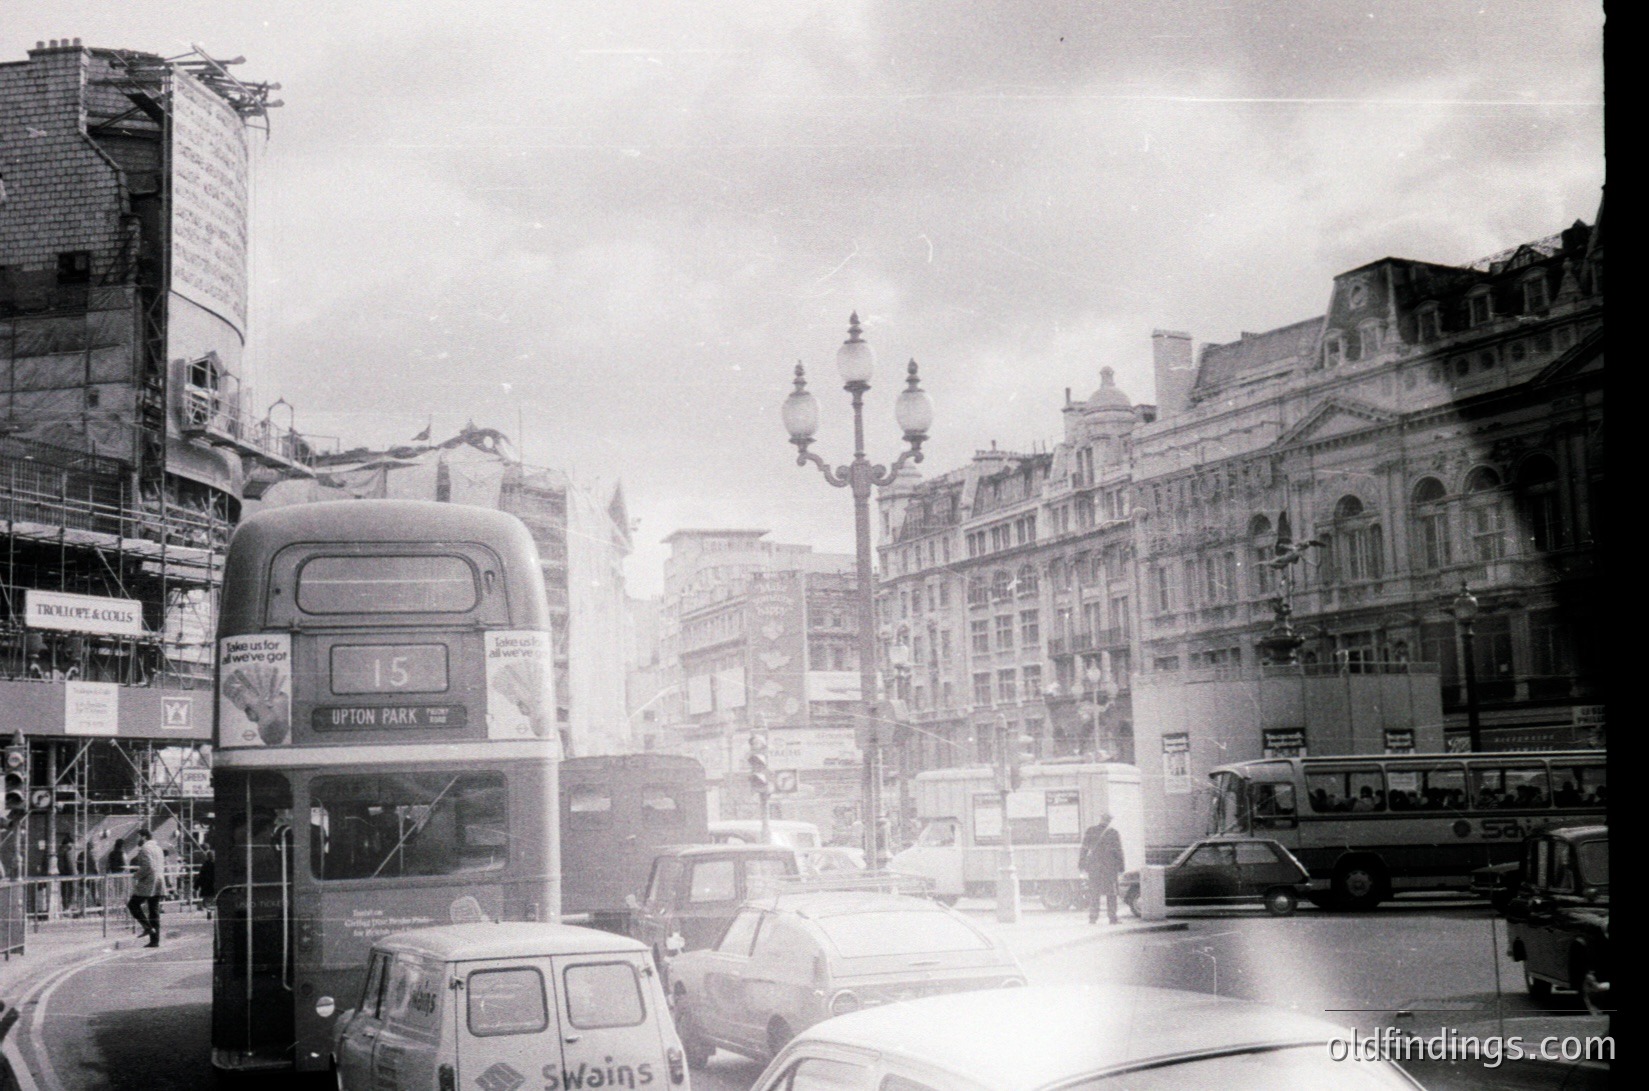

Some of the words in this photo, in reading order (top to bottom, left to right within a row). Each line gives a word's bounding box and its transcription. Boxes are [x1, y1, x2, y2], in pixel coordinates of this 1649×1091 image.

[37, 603, 90, 619] TROLLOPE
[92, 609, 100, 620] &
[101, 610, 133, 623] COLLS
[226, 641, 248, 652] Take
[250, 643, 262, 651] us
[263, 640, 279, 650] for
[495, 637, 518, 647] Take
[519, 639, 531, 647] us
[222, 654, 231, 665] all
[232, 652, 265, 663] we've
[267, 651, 287, 664] got
[489, 648, 501, 658] all
[502, 649, 533, 658] we've
[374, 656, 409, 688] 15
[332, 708, 376, 725] UPTON
[381, 708, 418, 724] PARK
[542, 1056, 654, 1091] Swains
